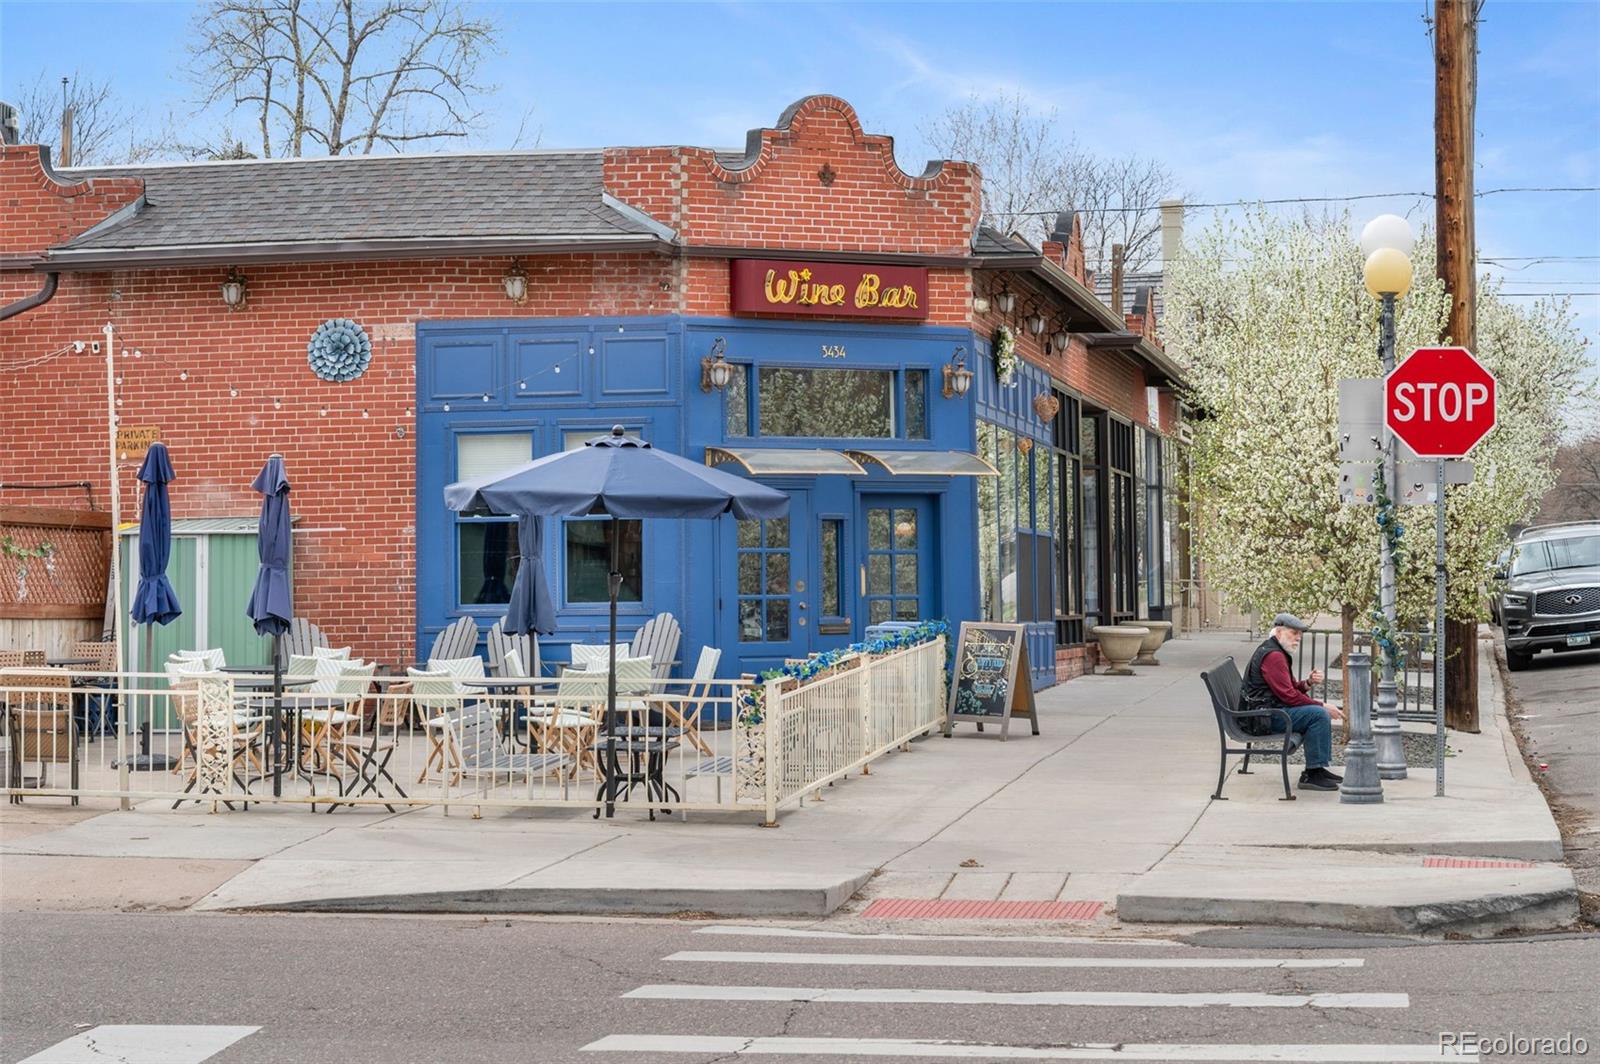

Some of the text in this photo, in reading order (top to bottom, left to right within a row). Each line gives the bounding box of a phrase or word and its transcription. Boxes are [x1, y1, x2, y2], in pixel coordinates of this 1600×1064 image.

[764, 268, 919, 309] Wine Bar
[822, 345, 846, 358] 3434
[1393, 382, 1489, 422] STOP
[116, 429, 158, 440] PRIVATE
[115, 440, 153, 451] PARKIN
